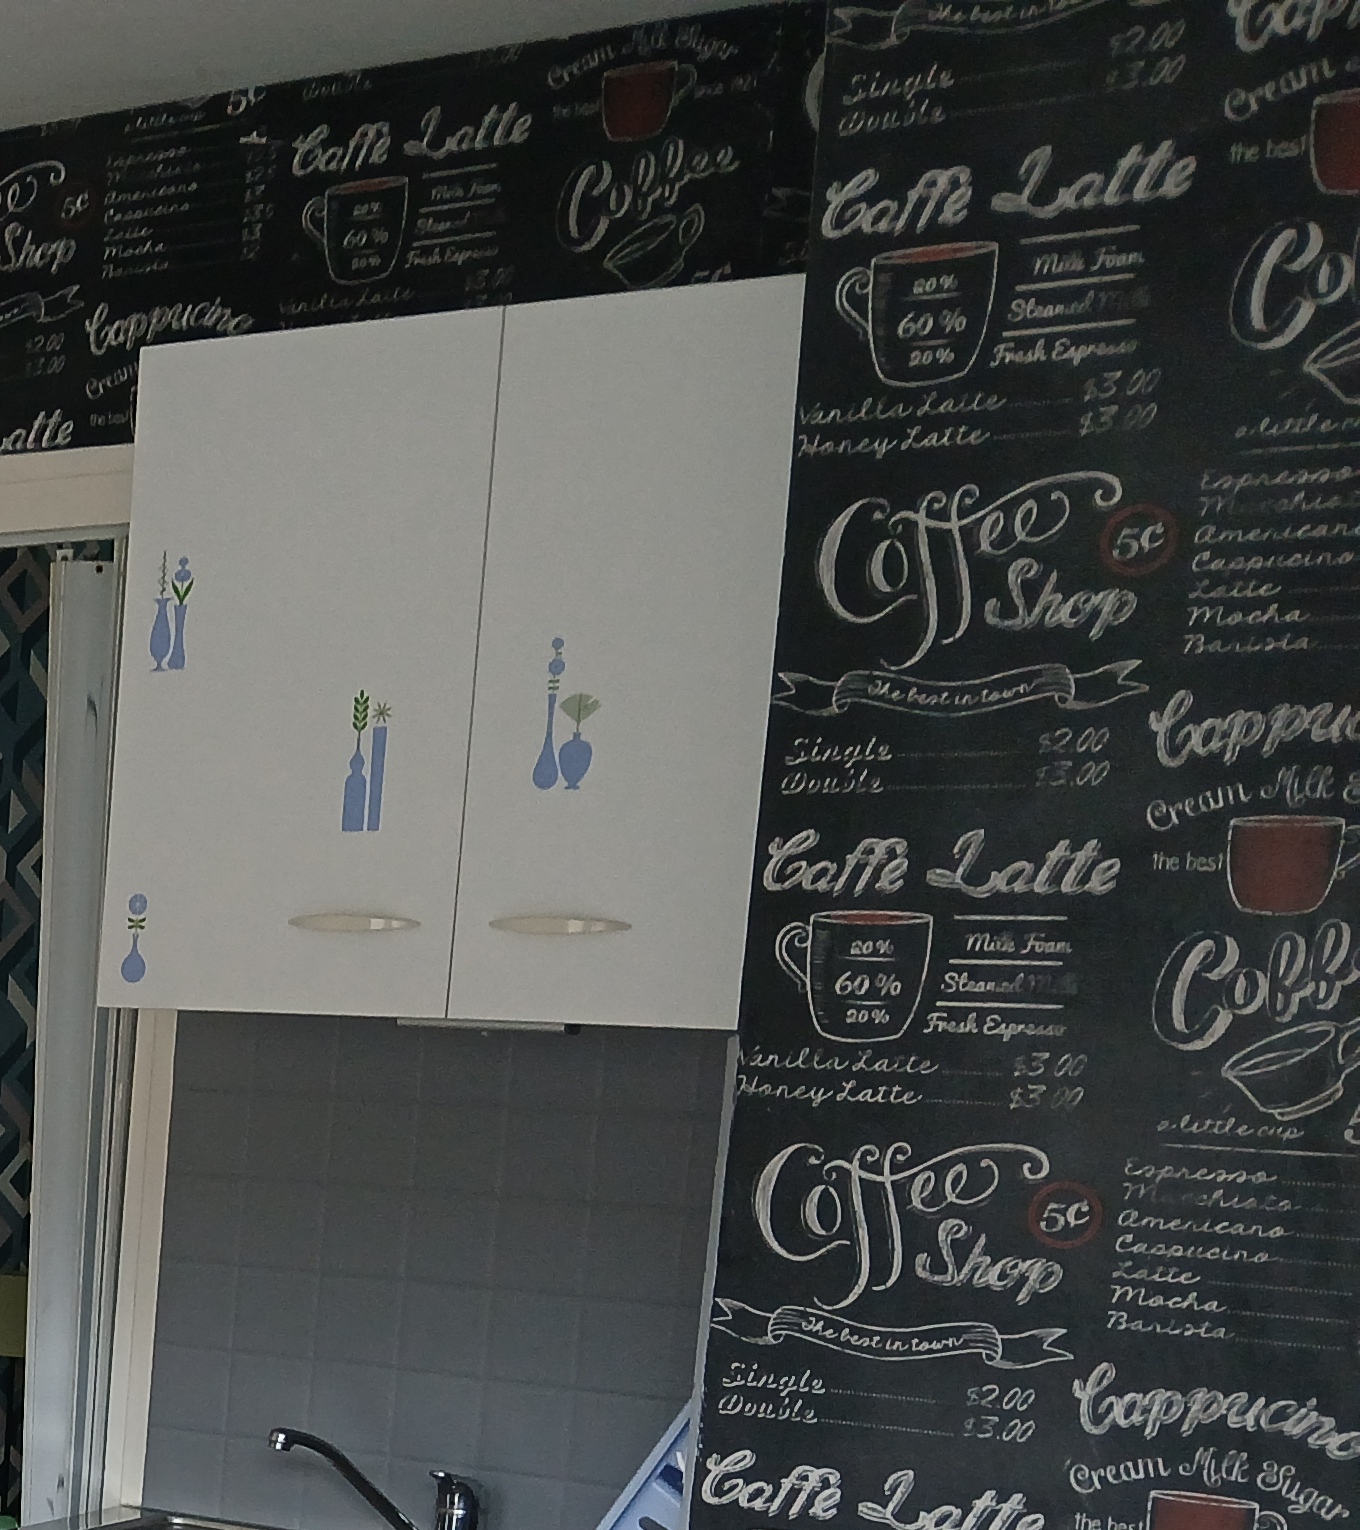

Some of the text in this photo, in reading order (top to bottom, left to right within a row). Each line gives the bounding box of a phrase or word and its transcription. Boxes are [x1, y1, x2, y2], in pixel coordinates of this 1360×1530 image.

[404, 102, 532, 158] Latte
[555, 135, 741, 254] Coffee
[991, 139, 1196, 218] Latte
[815, 471, 1122, 670] Coffee
[1111, 521, 1164, 560] 5¢
[985, 556, 1136, 641] Shop
[1147, 782, 1251, 831] Cream
[926, 828, 1122, 898] Latte
[1153, 852, 1224, 871] the best
[752, 1142, 1050, 1309] Coffee
[1039, 1201, 1090, 1233] 5¢
[916, 1219, 1064, 1304] Shop
[721, 1362, 825, 1397] Single
[1070, 1447, 1350, 1521] Cream Milk Sugar
